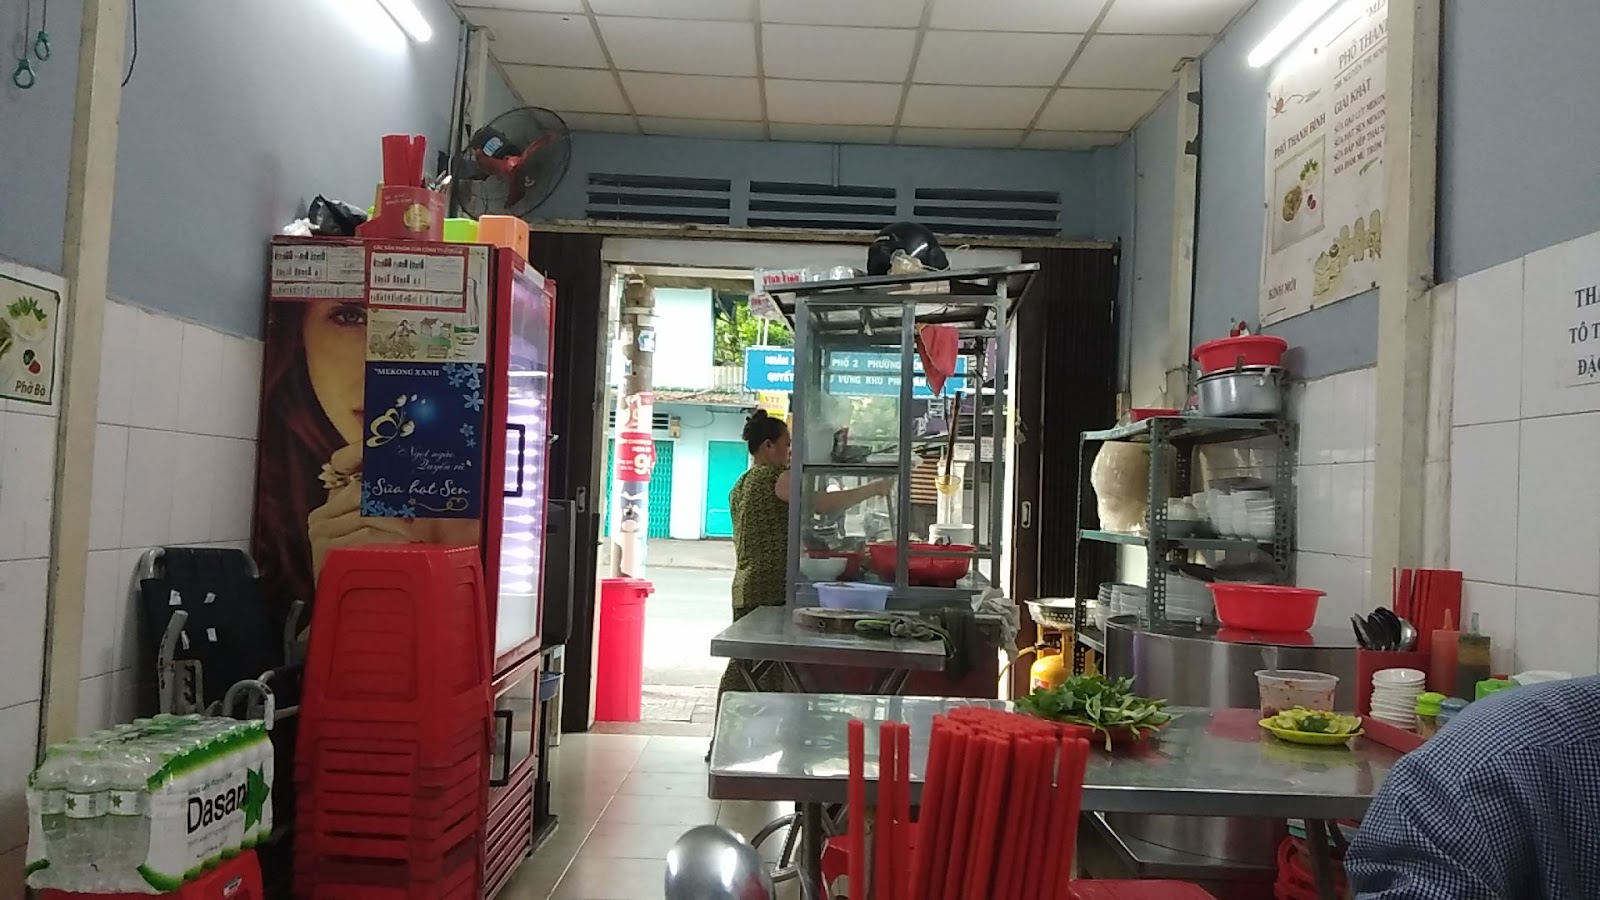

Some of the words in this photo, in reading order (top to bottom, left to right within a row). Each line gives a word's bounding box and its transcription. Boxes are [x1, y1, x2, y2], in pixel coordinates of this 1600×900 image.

[1288, 125, 1308, 149] THANH
[1574, 285, 1600, 308] TH
[1569, 321, 1588, 344] TÔ
[832, 355, 850, 368] PHỐ
[852, 359, 859, 368] 2
[866, 375, 883, 385] KHU
[34, 384, 46, 396] Bò
[440, 479, 470, 497] Sen
